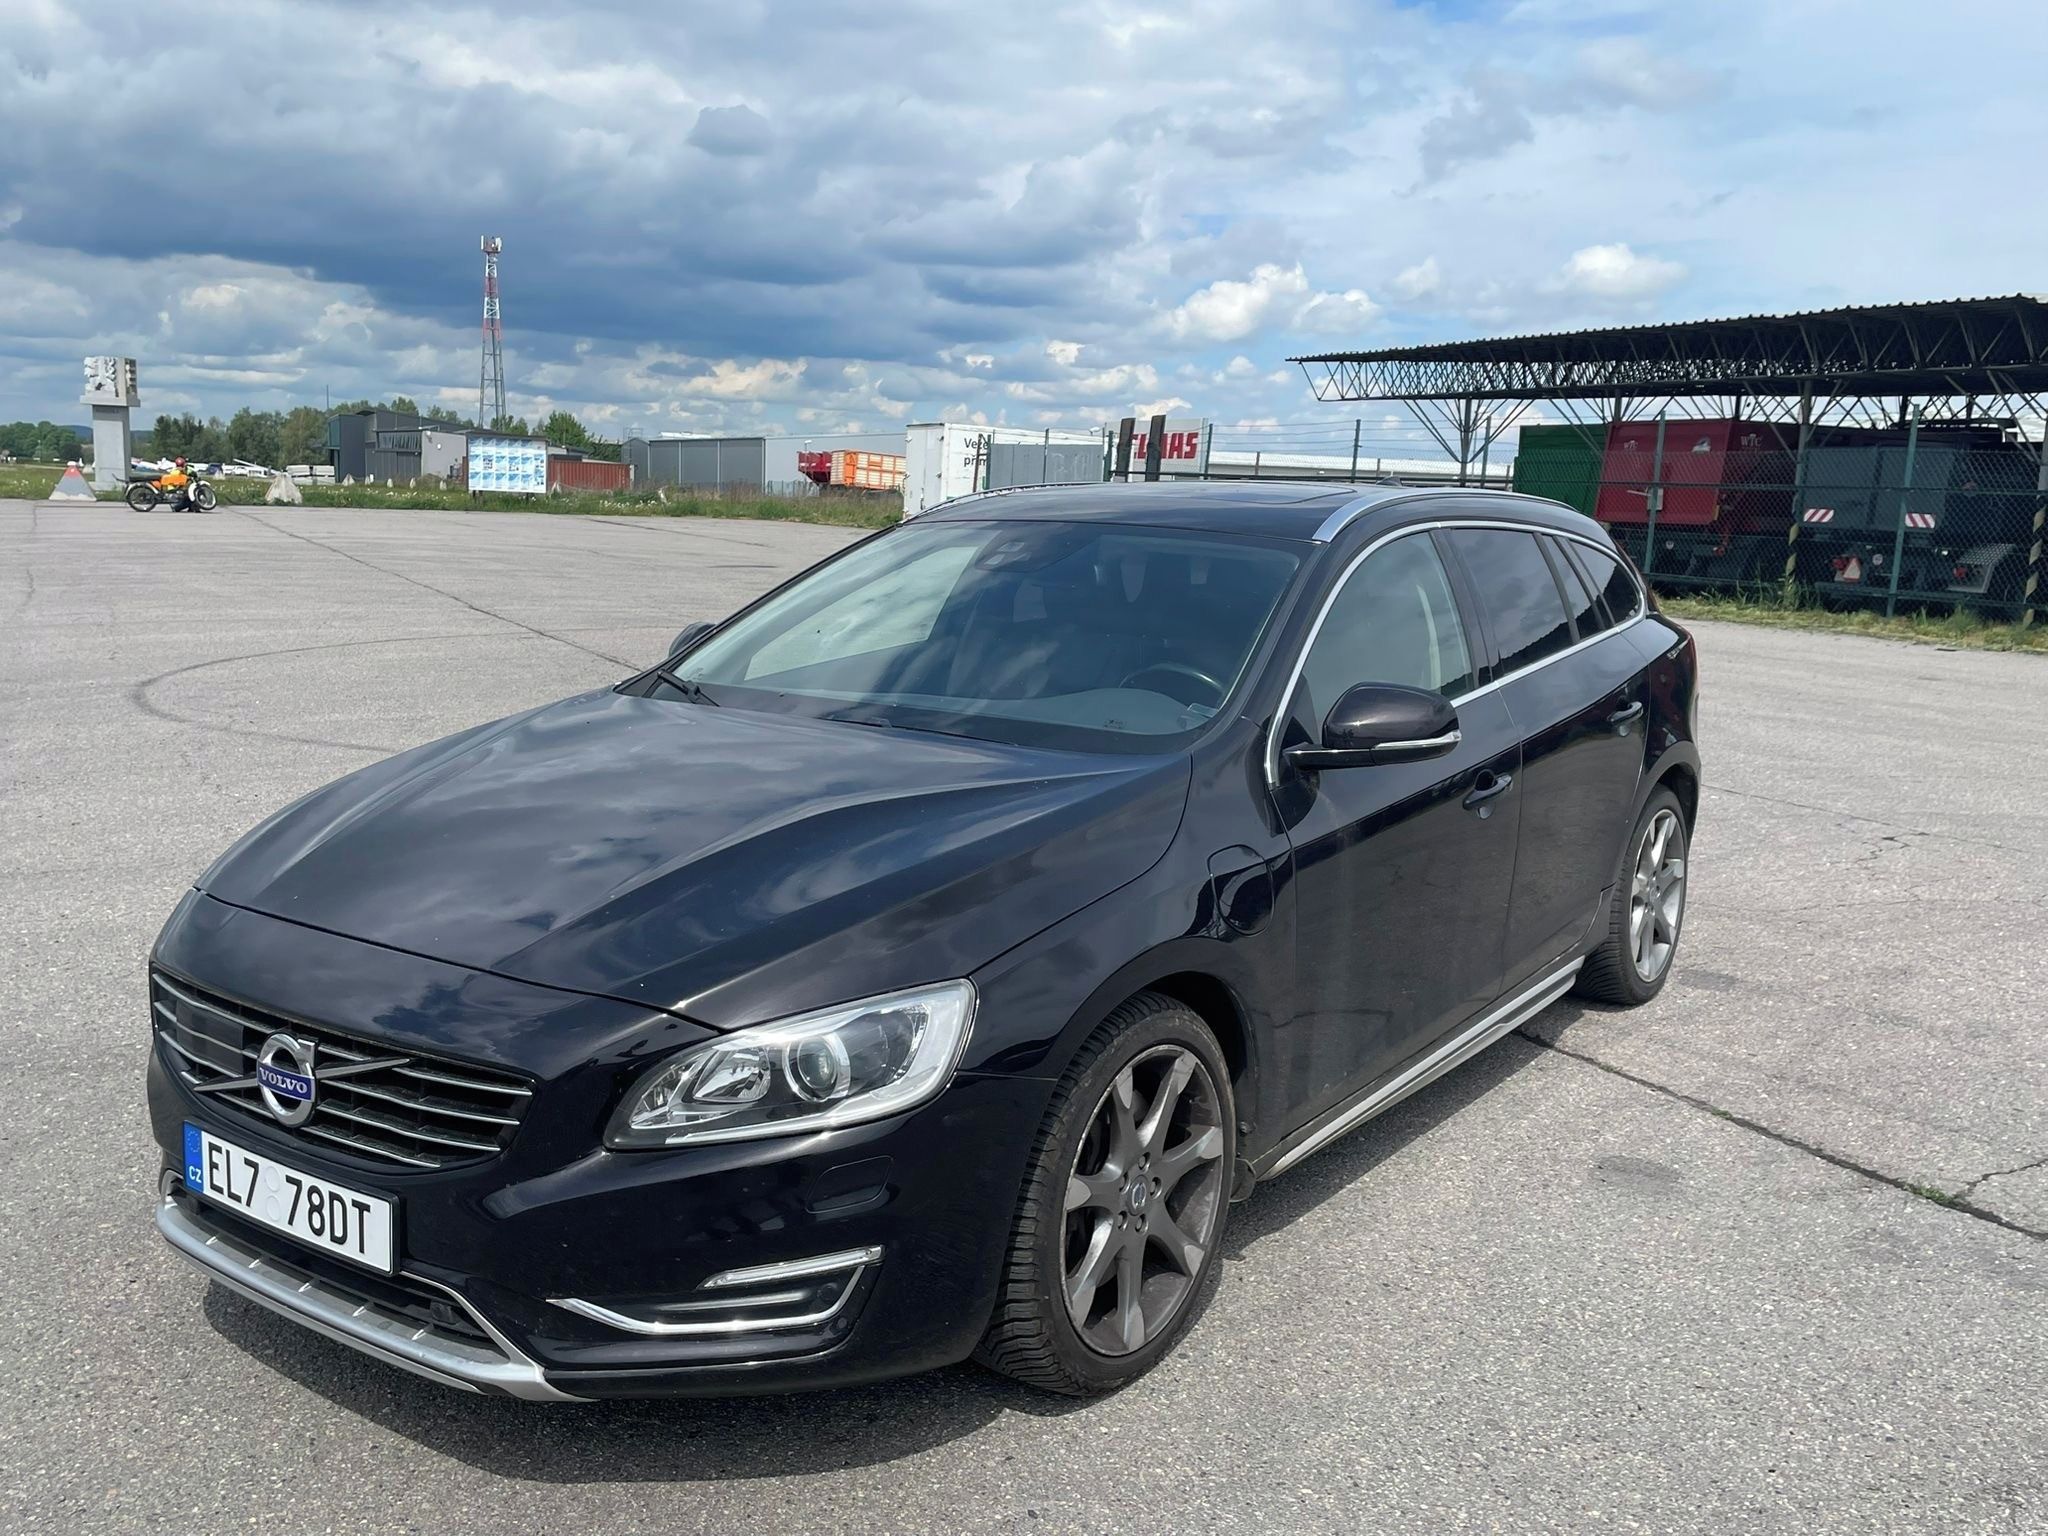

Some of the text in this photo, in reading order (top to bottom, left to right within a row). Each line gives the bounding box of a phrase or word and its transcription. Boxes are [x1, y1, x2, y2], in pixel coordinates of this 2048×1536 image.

[259, 1067, 308, 1094] VOLVO
[189, 1165, 202, 1183] CZ
[208, 1141, 371, 1254] EL7 78DT
